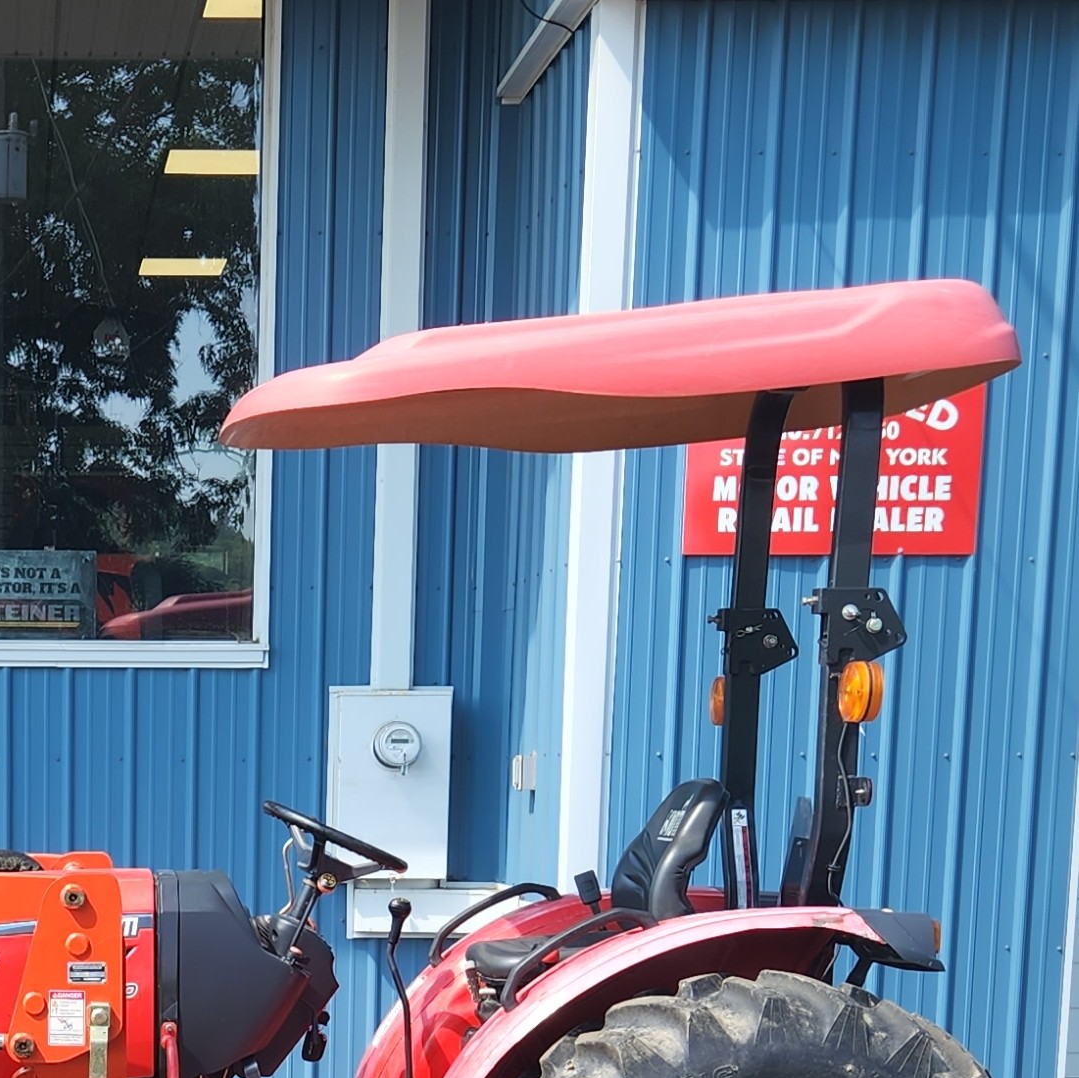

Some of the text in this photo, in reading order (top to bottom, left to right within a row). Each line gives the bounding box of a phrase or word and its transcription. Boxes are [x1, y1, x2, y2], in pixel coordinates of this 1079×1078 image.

[720, 448, 786, 466] STE
[792, 448, 823, 466] OF
[885, 448, 948, 466] YORK
[713, 475, 819, 501] MOR
[718, 506, 944, 532] RAIL ALER
[14, 567, 47, 579] NOT
[50, 567, 61, 579] A
[39, 582, 67, 594] IT'S
[70, 582, 81, 594] A
